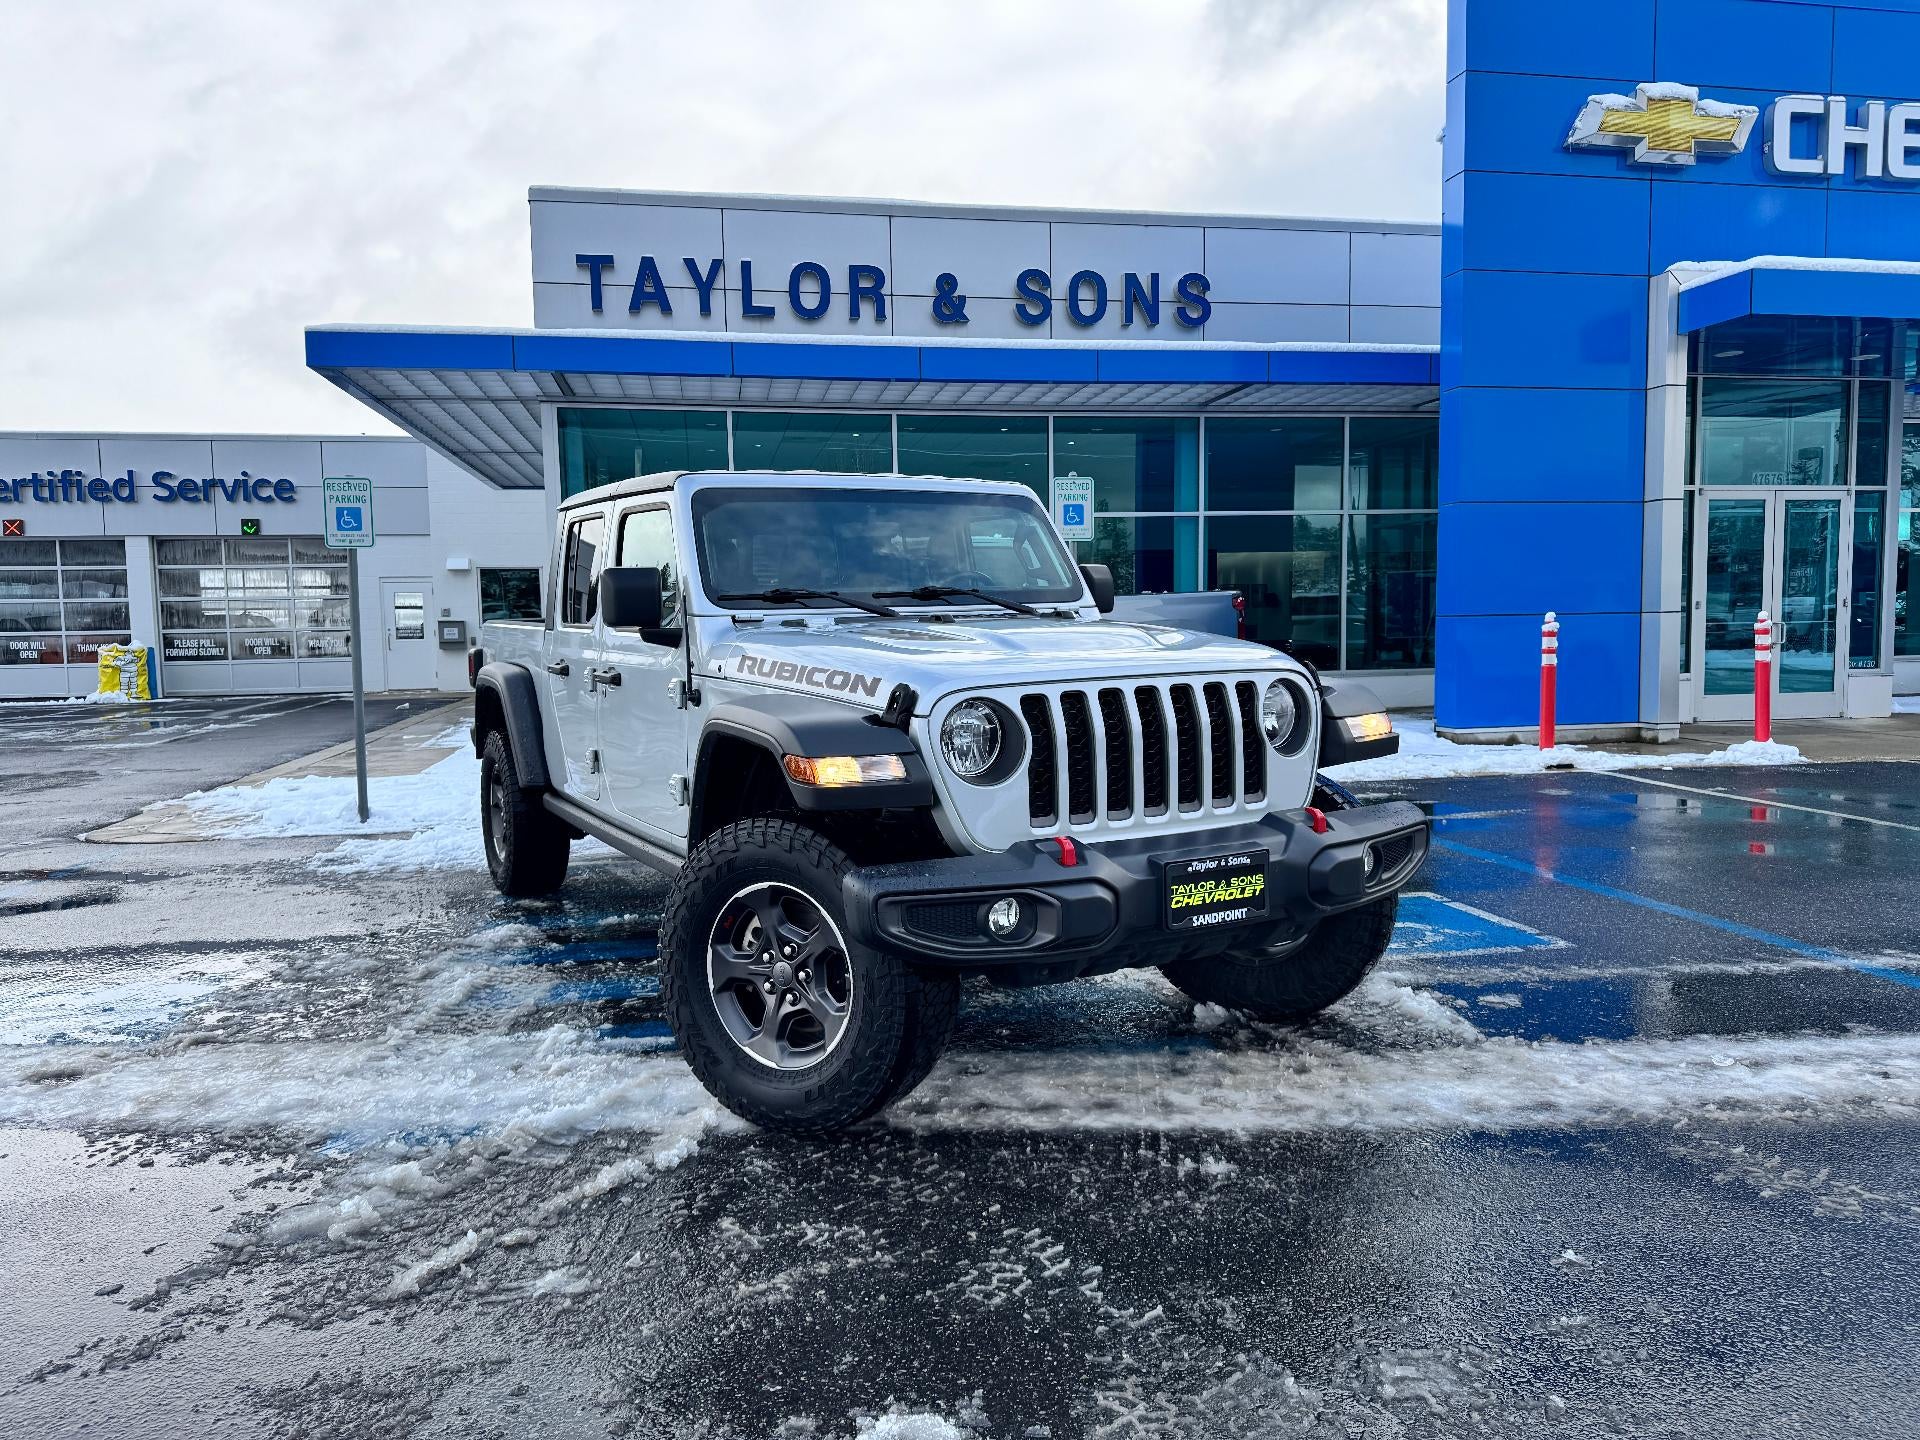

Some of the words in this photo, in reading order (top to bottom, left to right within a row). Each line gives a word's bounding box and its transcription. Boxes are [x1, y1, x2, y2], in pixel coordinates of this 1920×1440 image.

[576, 253, 887, 321] TAYLOR
[931, 272, 970, 323] &
[1014, 268, 1212, 328] SONS
[152, 470, 296, 503] Service
[326, 482, 368, 492] RESERVED
[1056, 482, 1090, 491] RESERVED
[329, 494, 367, 504] PARKING
[1058, 493, 1088, 502] PARKING
[9, 641, 29, 650] DOOR
[29, 641, 47, 650] WILL
[174, 639, 199, 648] PLEASE
[199, 638, 216, 647] PULL
[245, 638, 264, 647] DOOR
[264, 638, 280, 646] WILL
[77, 643, 99, 653] THANK
[165, 648, 198, 657] FORWARD
[198, 647, 225, 656] SLOWLY
[254, 647, 272, 655] OPEN
[20, 650, 38, 659] OPEN
[736, 654, 882, 698] RUBICON
[1191, 860, 1218, 873] Taylor
[1220, 858, 1226, 866] &
[1227, 856, 1248, 866] Sons
[1170, 880, 1216, 896] TAYLOR
[1218, 879, 1227, 890] &
[1230, 873, 1264, 887] SONS
[1170, 885, 1264, 909] CHEVROLET
[1192, 908, 1248, 926] SANDPOINT
